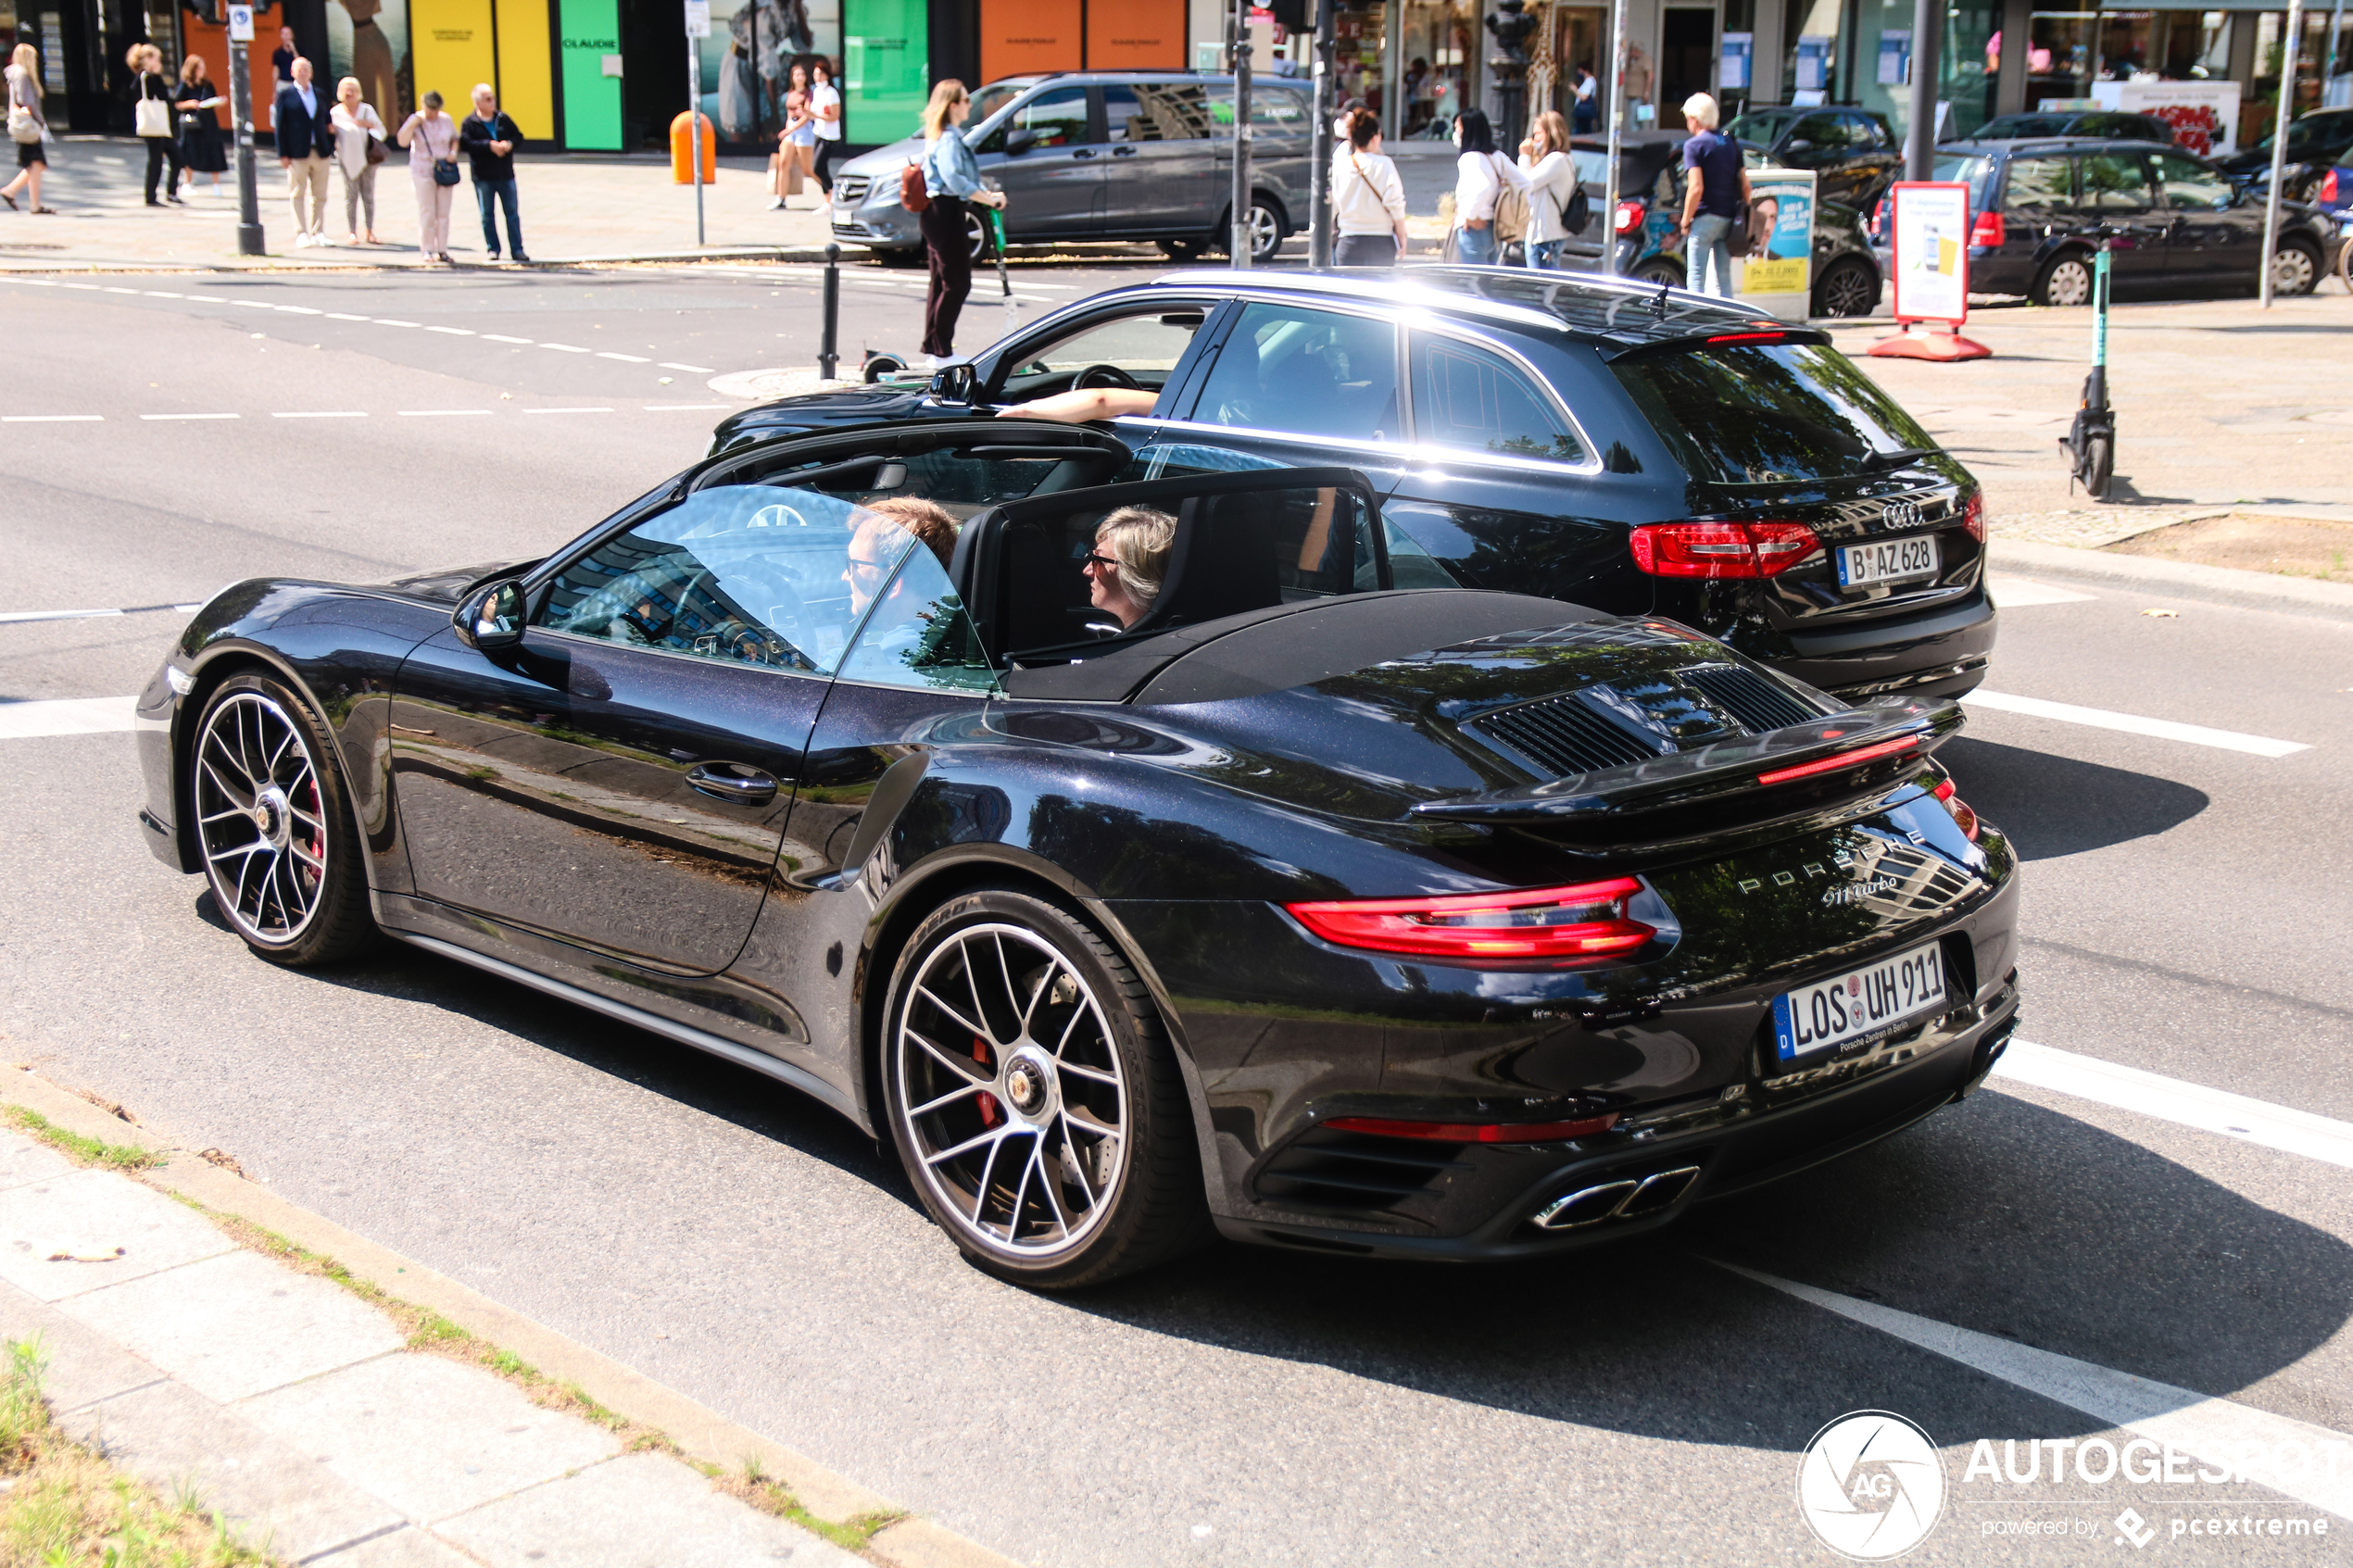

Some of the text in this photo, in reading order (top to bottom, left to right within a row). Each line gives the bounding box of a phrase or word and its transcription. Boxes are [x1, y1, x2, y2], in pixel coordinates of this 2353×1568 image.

[561, 39, 617, 49] CLAUDIE
[1853, 550, 1866, 580] B
[1878, 545, 1899, 576] AZ
[1901, 540, 1931, 571] 628
[1738, 830, 1925, 894] PORSCHE
[1820, 875, 1897, 909] 911 turbo
[916, 901, 967, 947] ZERO
[1780, 947, 1943, 1050] D LOS UH 911
[1840, 1021, 1908, 1052] Porsche Zentren in Berlin
